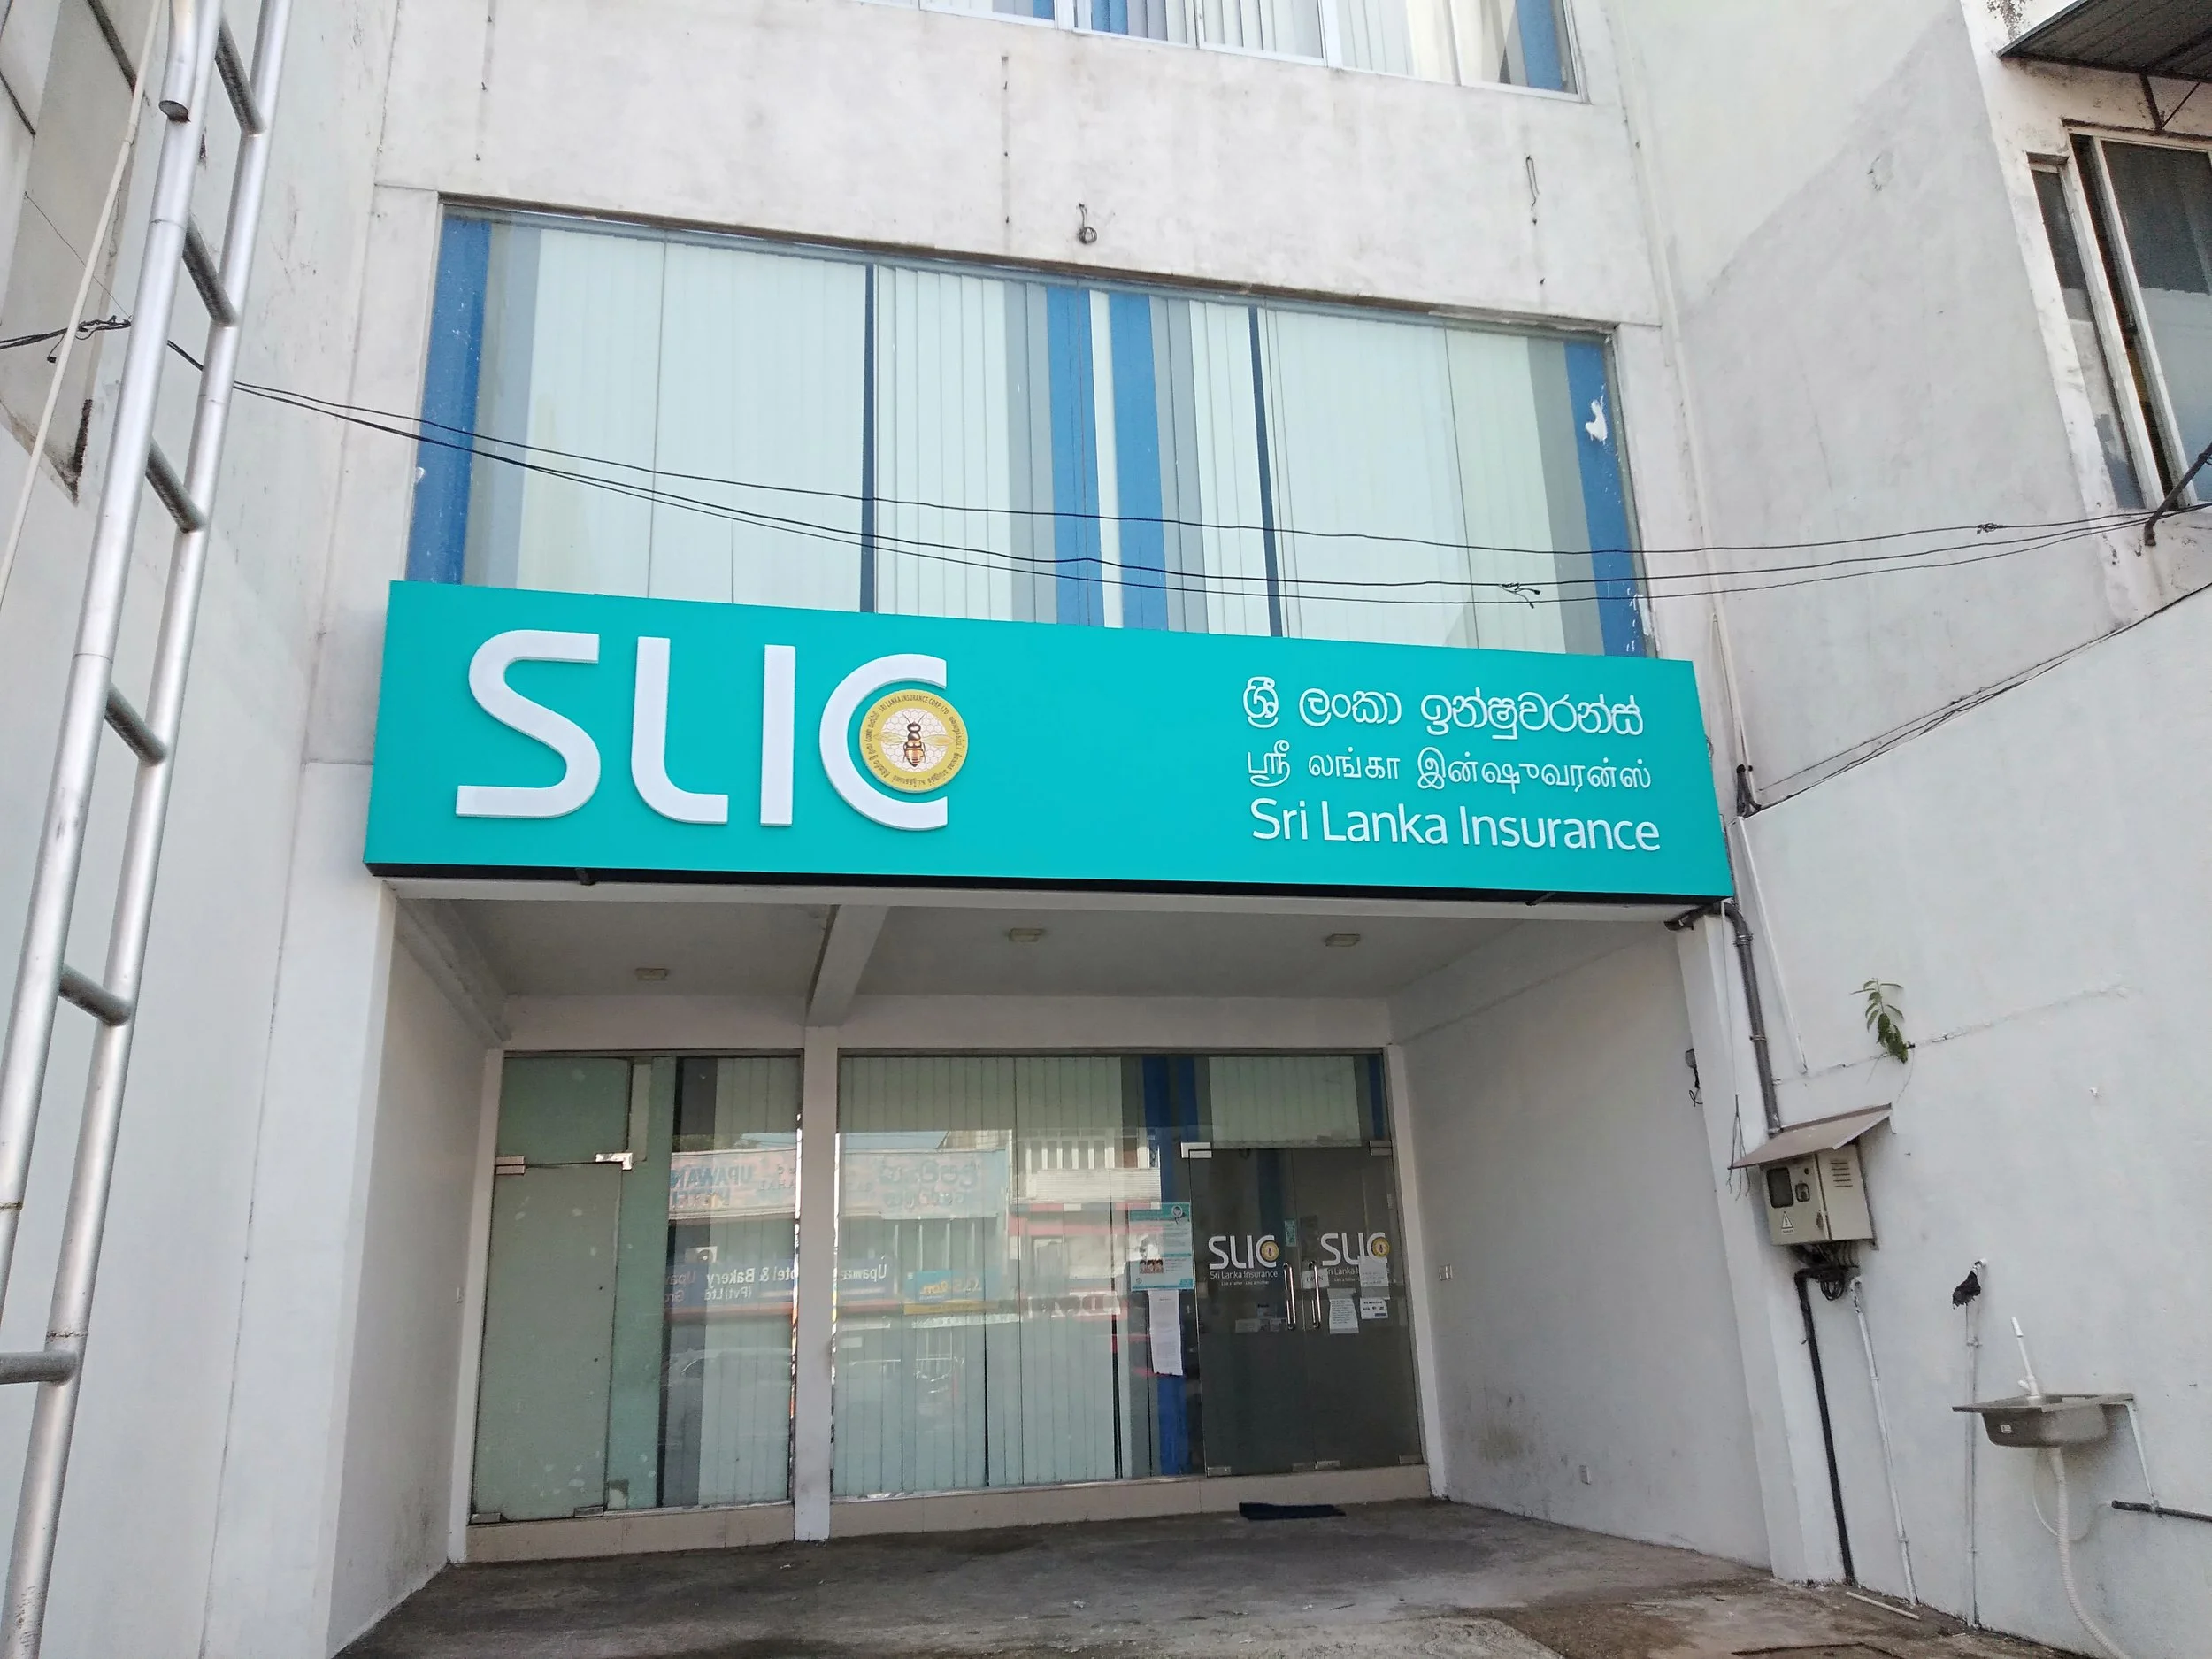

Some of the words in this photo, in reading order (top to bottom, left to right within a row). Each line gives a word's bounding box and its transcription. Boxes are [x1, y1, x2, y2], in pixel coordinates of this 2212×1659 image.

[885, 695, 902, 708] LANKA
[902, 694, 929, 703] INSURANCE
[1298, 687, 1403, 727] ලංකා
[455, 629, 949, 831] SLIC
[1308, 746, 1402, 780] லங்கா
[1250, 797, 1309, 841] Sri
[1321, 800, 1448, 845] Lanka
[1459, 805, 1661, 852] Insurance
[1208, 1234, 1278, 1270] SLIC
[1210, 1271, 1220, 1279] Sri
[1221, 1271, 1242, 1279] Lanka
[1243, 1270, 1279, 1279] Insurance
